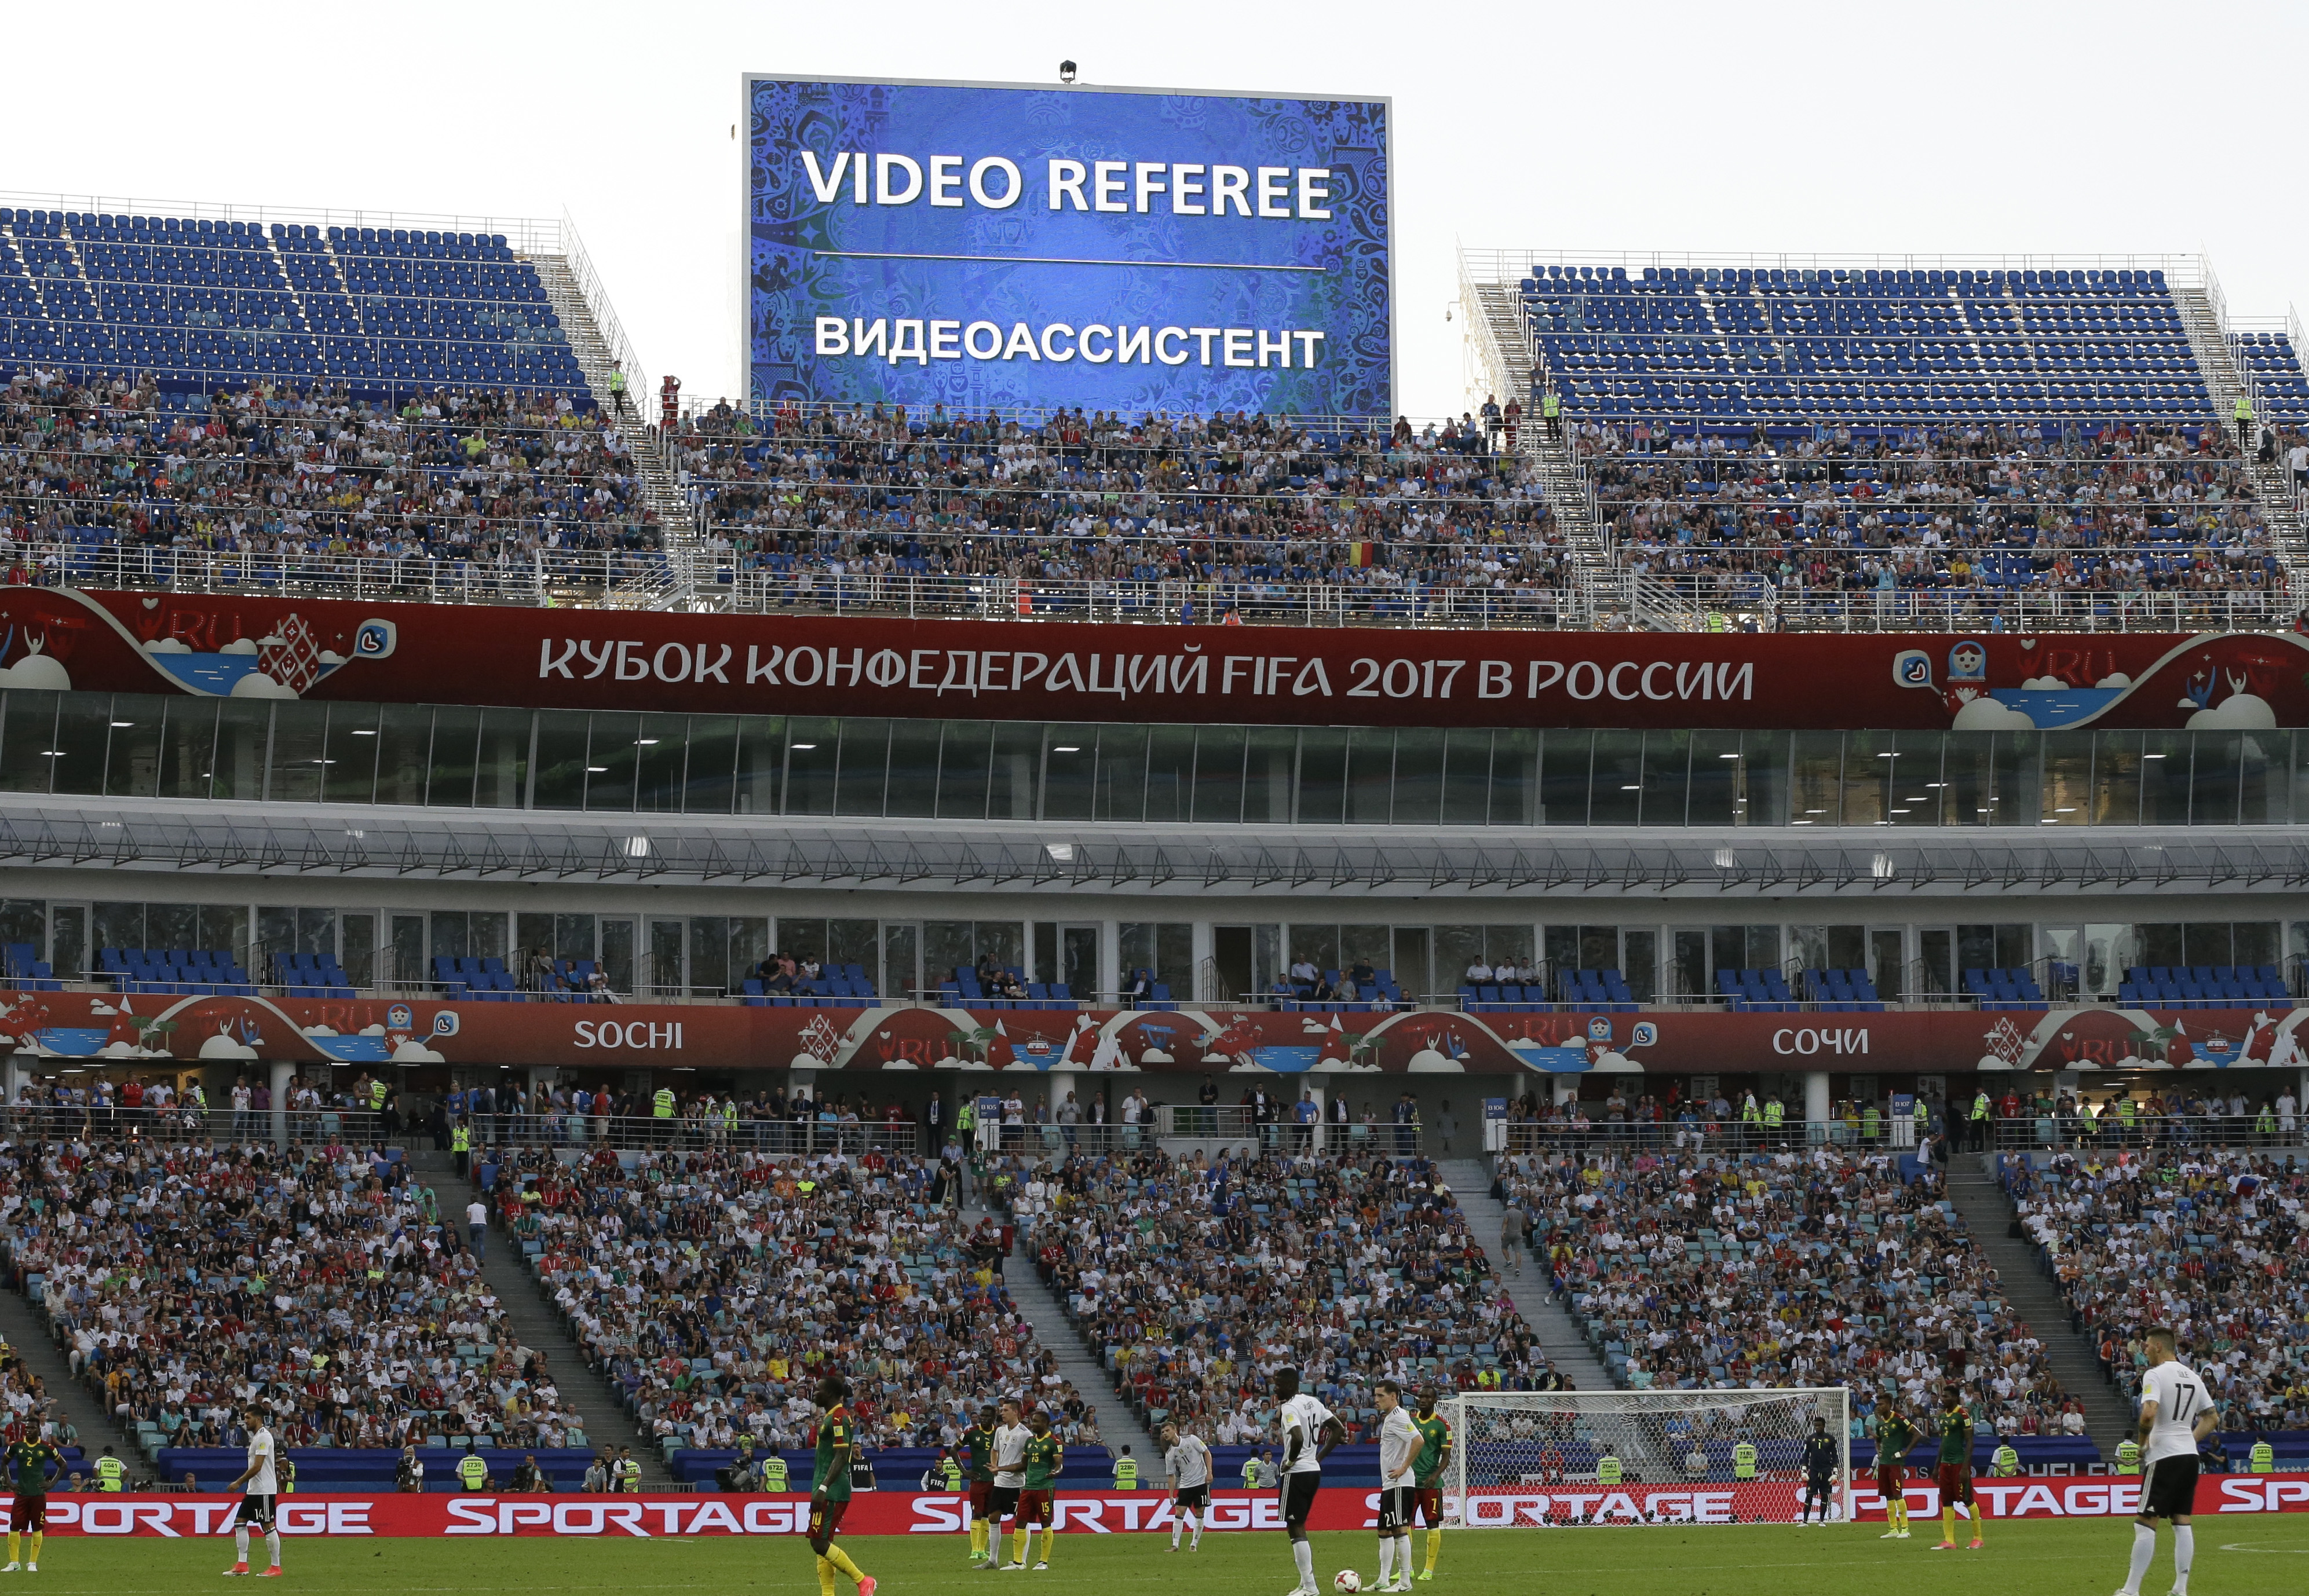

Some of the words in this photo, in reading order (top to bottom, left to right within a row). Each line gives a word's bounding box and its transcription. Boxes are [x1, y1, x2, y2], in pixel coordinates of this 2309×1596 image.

[801, 151, 1022, 209] VIDEO
[1049, 159, 1331, 219] REFEREE
[815, 316, 1324, 369] ВИДЕОАССИСТЕНТ
[539, 638, 732, 683] КУБОК
[746, 643, 1208, 701] КОНФЕДЕРАЦИЙ
[1222, 655, 1333, 697] FIFA
[1346, 658, 1466, 698] 2017
[1478, 660, 1512, 698] В
[1527, 660, 1753, 701] РОССИИ
[573, 1020, 682, 1049] SOCHI
[1773, 1028, 1868, 1055] СОЧИ
[2172, 1383, 2195, 1421] 17
[1307, 1413, 1318, 1448] 16
[985, 1441, 990, 1450] 5
[1002, 1444, 1007, 1454] 7
[27, 1457, 32, 1466] 2
[1031, 1453, 1039, 1463] 15
[1181, 1456, 1190, 1465] 11
[930, 1479, 945, 1488] FIFA
[1201, 1495, 1207, 1505] 11
[1431, 1498, 1437, 1509] 7
[1042, 1502, 1049, 1513] 15
[40, 1511, 45, 1521] 2
[255, 1509, 264, 1520] 14
[812, 1511, 822, 1526] 10
[1384, 1511, 1397, 1527] 21
